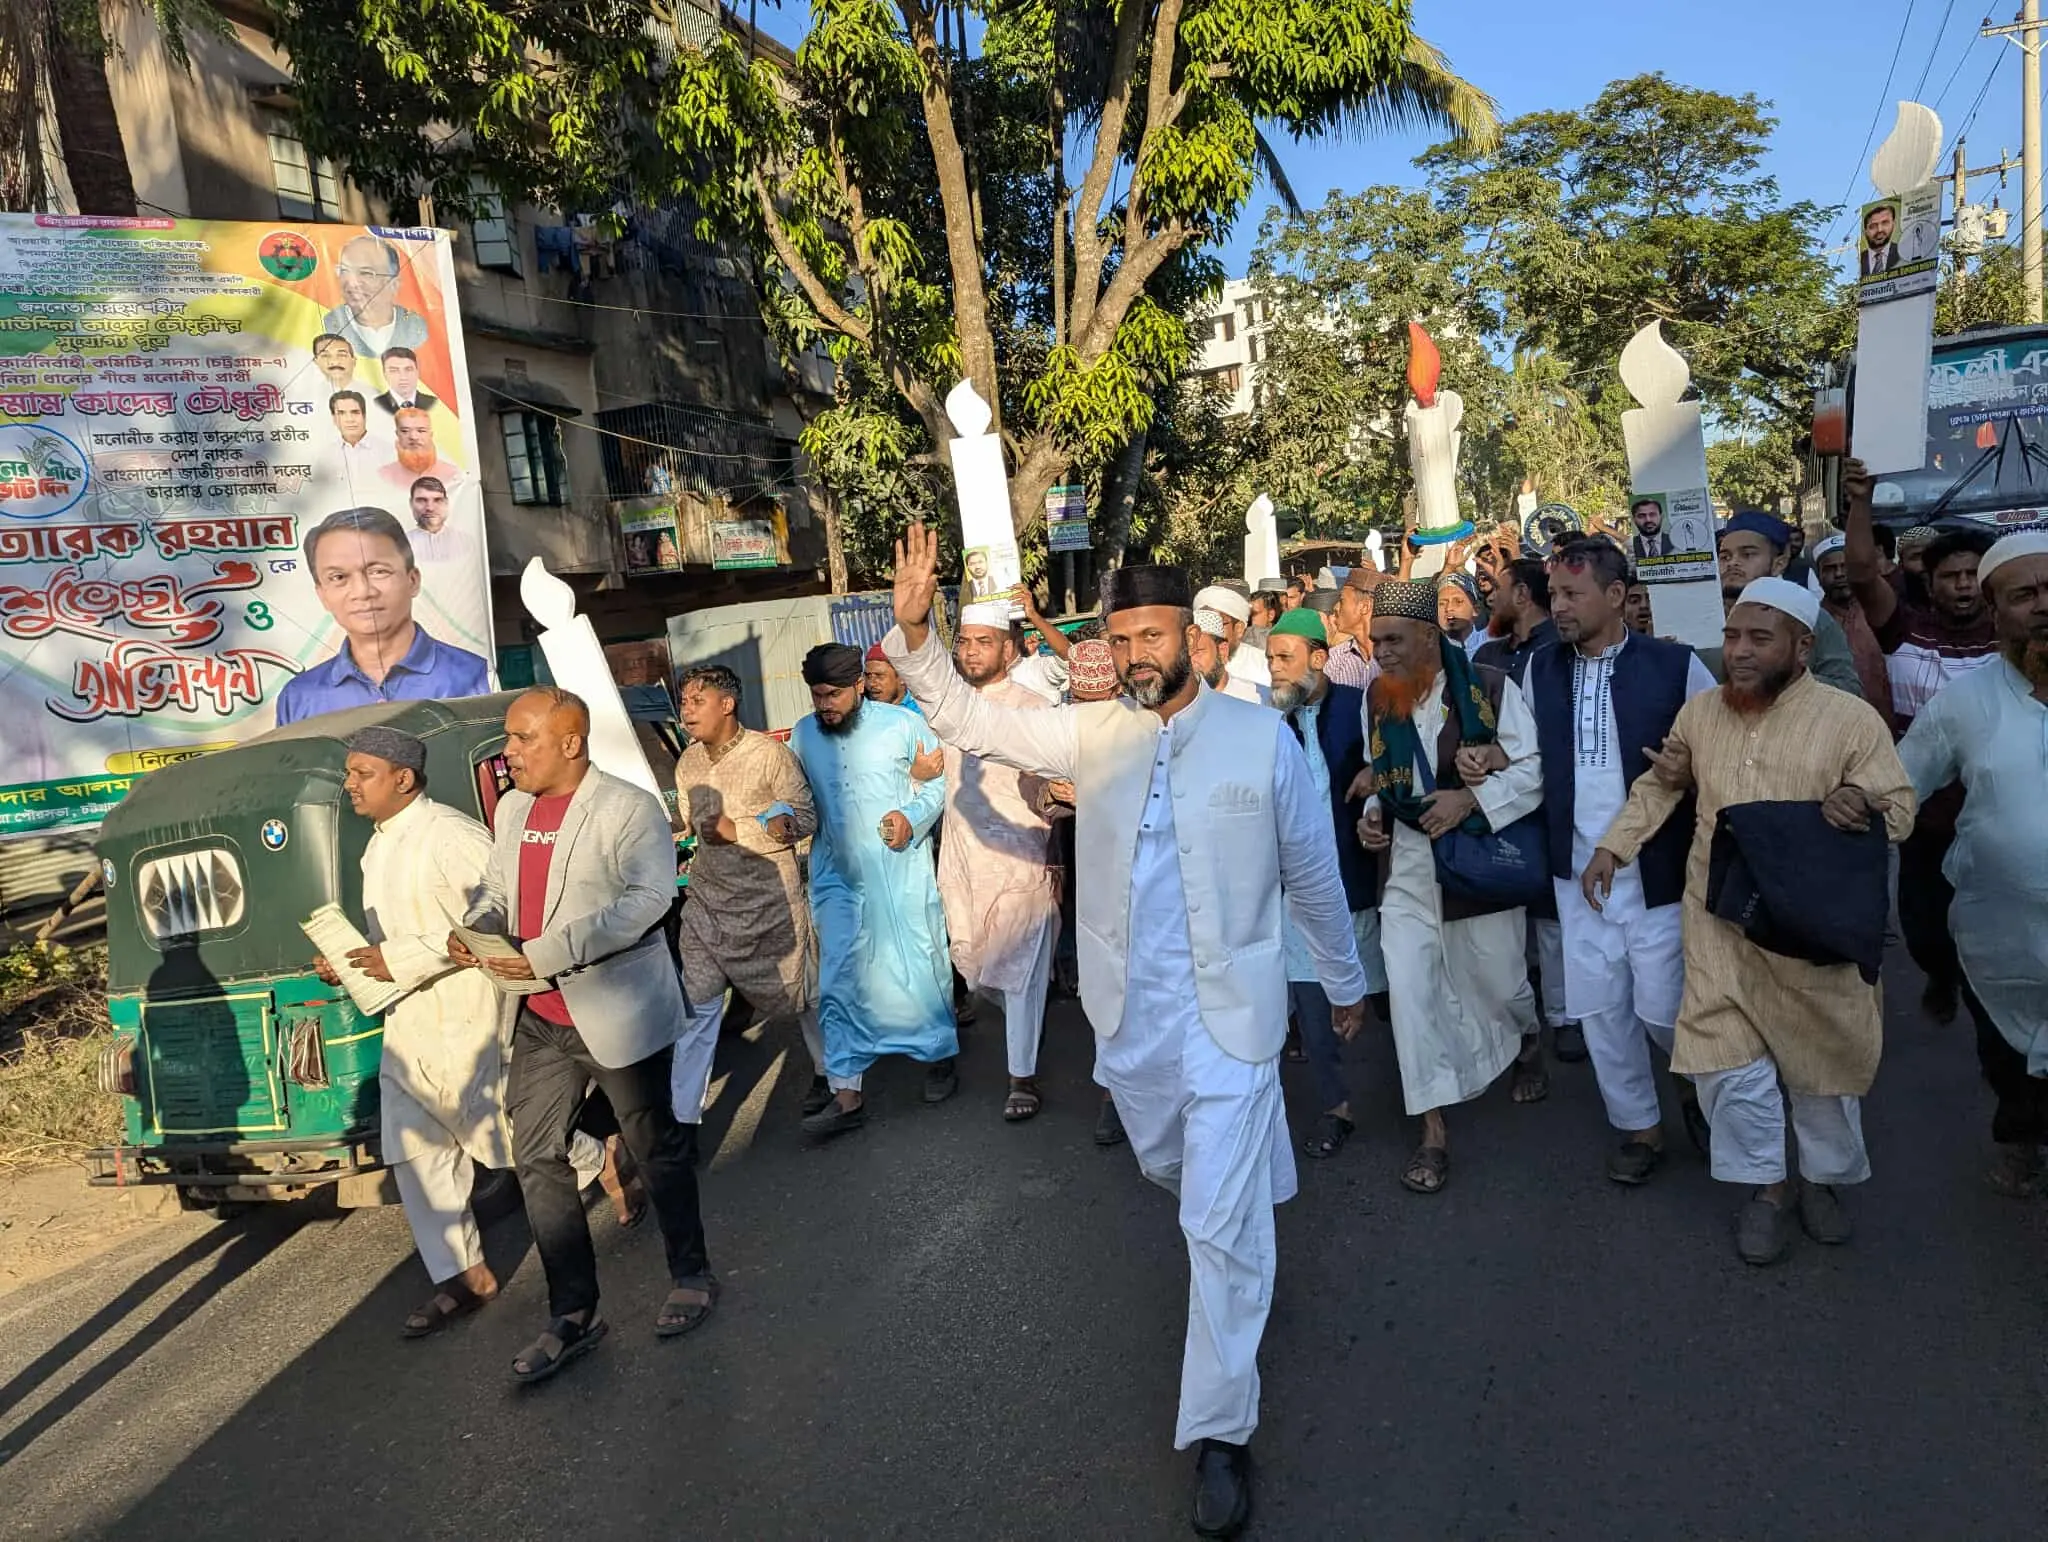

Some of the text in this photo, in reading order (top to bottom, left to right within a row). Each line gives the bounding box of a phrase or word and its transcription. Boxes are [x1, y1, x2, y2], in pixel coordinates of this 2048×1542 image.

[17, 302, 85, 315] জননেতা
[142, 298, 186, 315] শহীদ
[80, 318, 150, 333] কাদের
[55, 335, 170, 351] সুযোগ্য পুত্র
[92, 355, 153, 369] কমিটির
[160, 357, 200, 369] সদস্য
[44, 373, 92, 386] ধানের
[100, 370, 137, 384] শীষে
[143, 369, 209, 383] মনোনীত
[71, 390, 176, 416] কাদের
[186, 384, 284, 419] চৌধুরী
[286, 399, 313, 416] কে
[93, 429, 154, 446] মনোনীত
[160, 430, 198, 446] করায়
[271, 427, 309, 443] প্রতীক
[172, 448, 242, 462] দেশ নায়ক
[104, 463, 312, 483] বাংলাদেশ জাতীয়তাবাদী দলের
[146, 481, 278, 499] ভারপ্রাপ্ত চেয়ারম্যান
[0, 516, 294, 560] তারেক রহমান
[268, 559, 297, 575] কে
[0, 560, 275, 645] শুভেচ্ছা ও
[52, 640, 300, 715] অভিনন্দন
[56, 777, 133, 798] আলম
